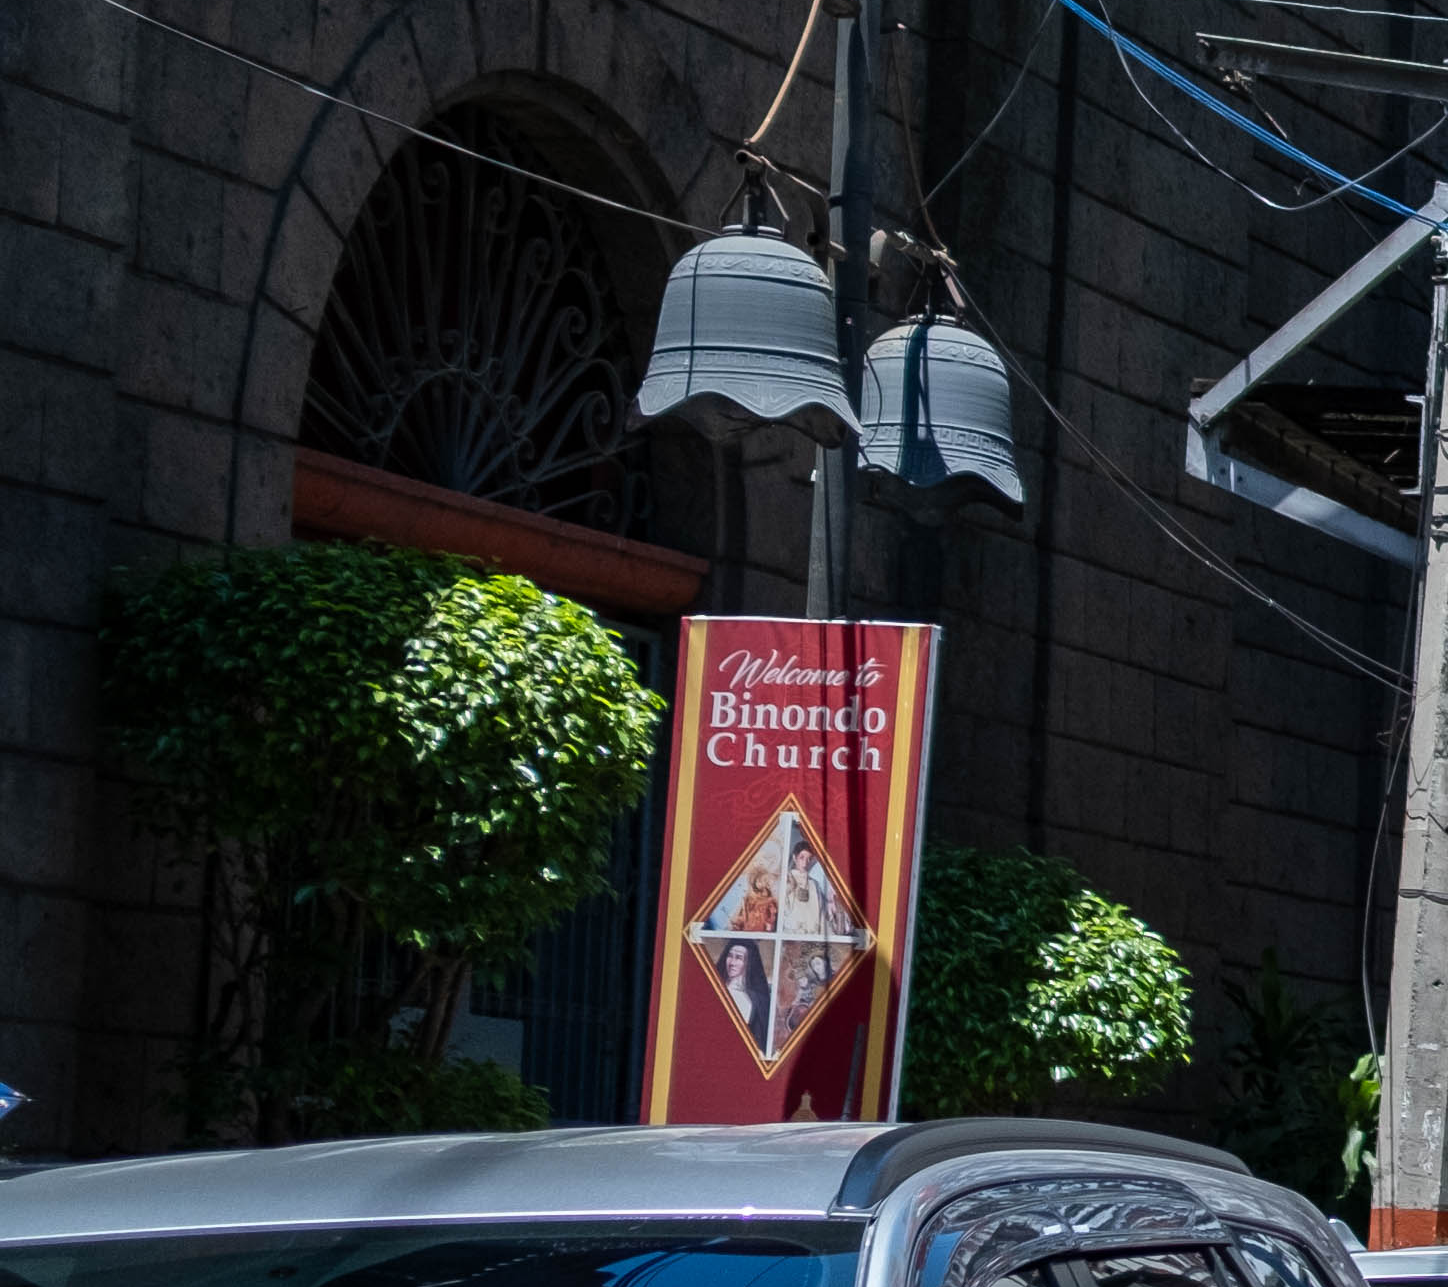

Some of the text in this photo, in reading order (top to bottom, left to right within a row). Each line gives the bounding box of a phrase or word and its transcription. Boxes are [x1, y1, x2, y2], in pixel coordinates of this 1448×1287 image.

[719, 649, 887, 688] Welcome to
[710, 690, 887, 734] Binondo
[706, 731, 882, 771] Church
